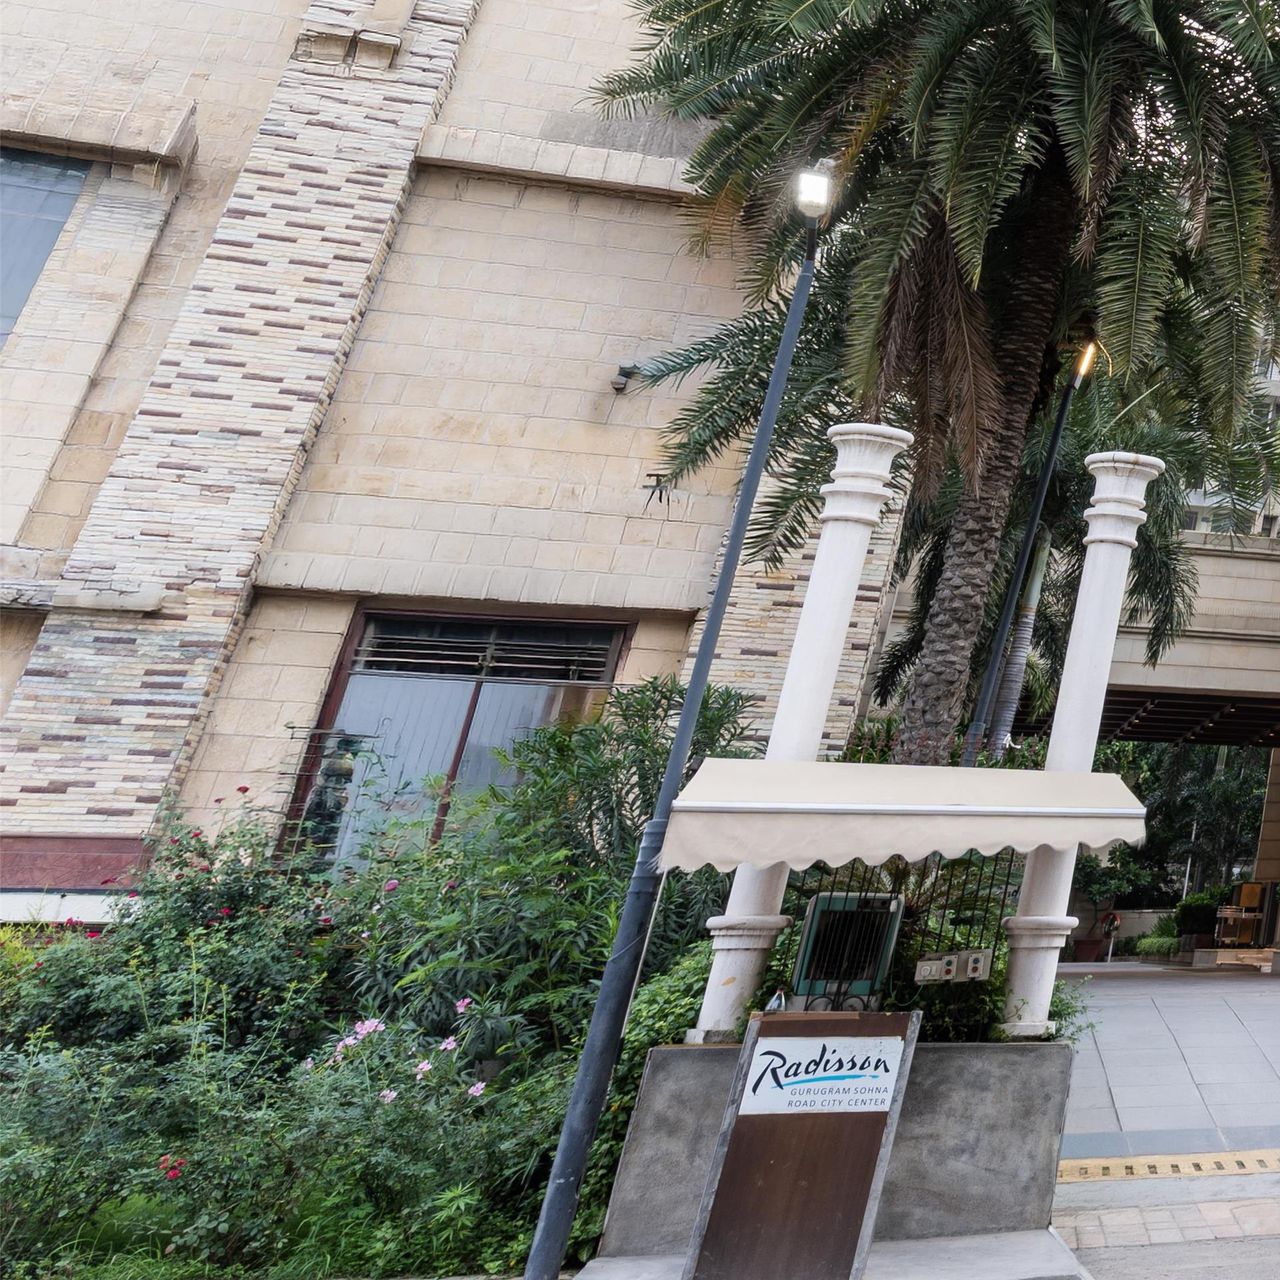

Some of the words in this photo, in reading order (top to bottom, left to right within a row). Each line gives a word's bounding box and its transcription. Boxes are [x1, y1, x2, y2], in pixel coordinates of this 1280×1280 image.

[751, 1043, 891, 1096] Radisson
[790, 1087, 851, 1096] GURUGRAM
[853, 1086, 889, 1095] SOHNA
[787, 1100, 817, 1108] ROAD
[820, 1099, 844, 1107] CITY
[847, 1098, 887, 1107] CENTER
